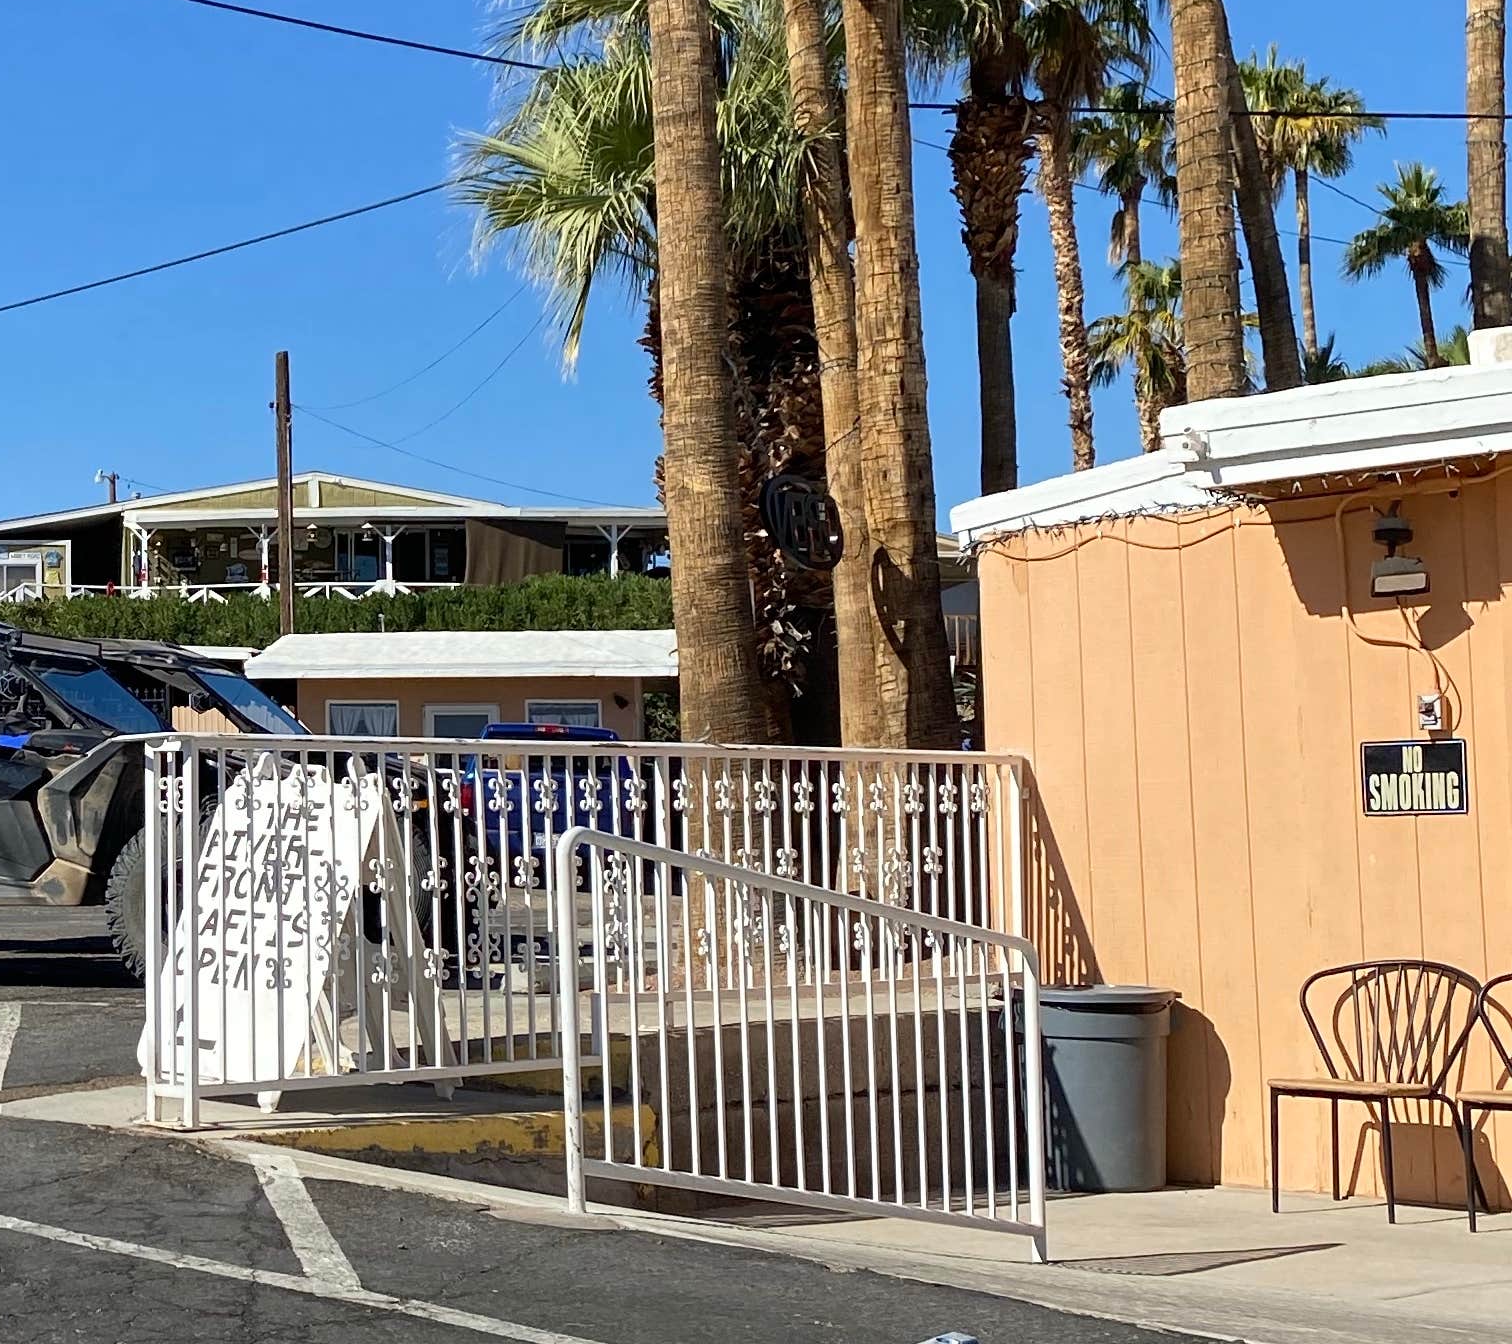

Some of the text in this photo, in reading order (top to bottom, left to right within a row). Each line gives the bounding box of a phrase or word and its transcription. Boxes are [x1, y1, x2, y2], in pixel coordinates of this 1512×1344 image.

[1402, 745, 1423, 773] NO
[1369, 771, 1460, 811] SMOKING
[266, 802, 325, 832] THE
